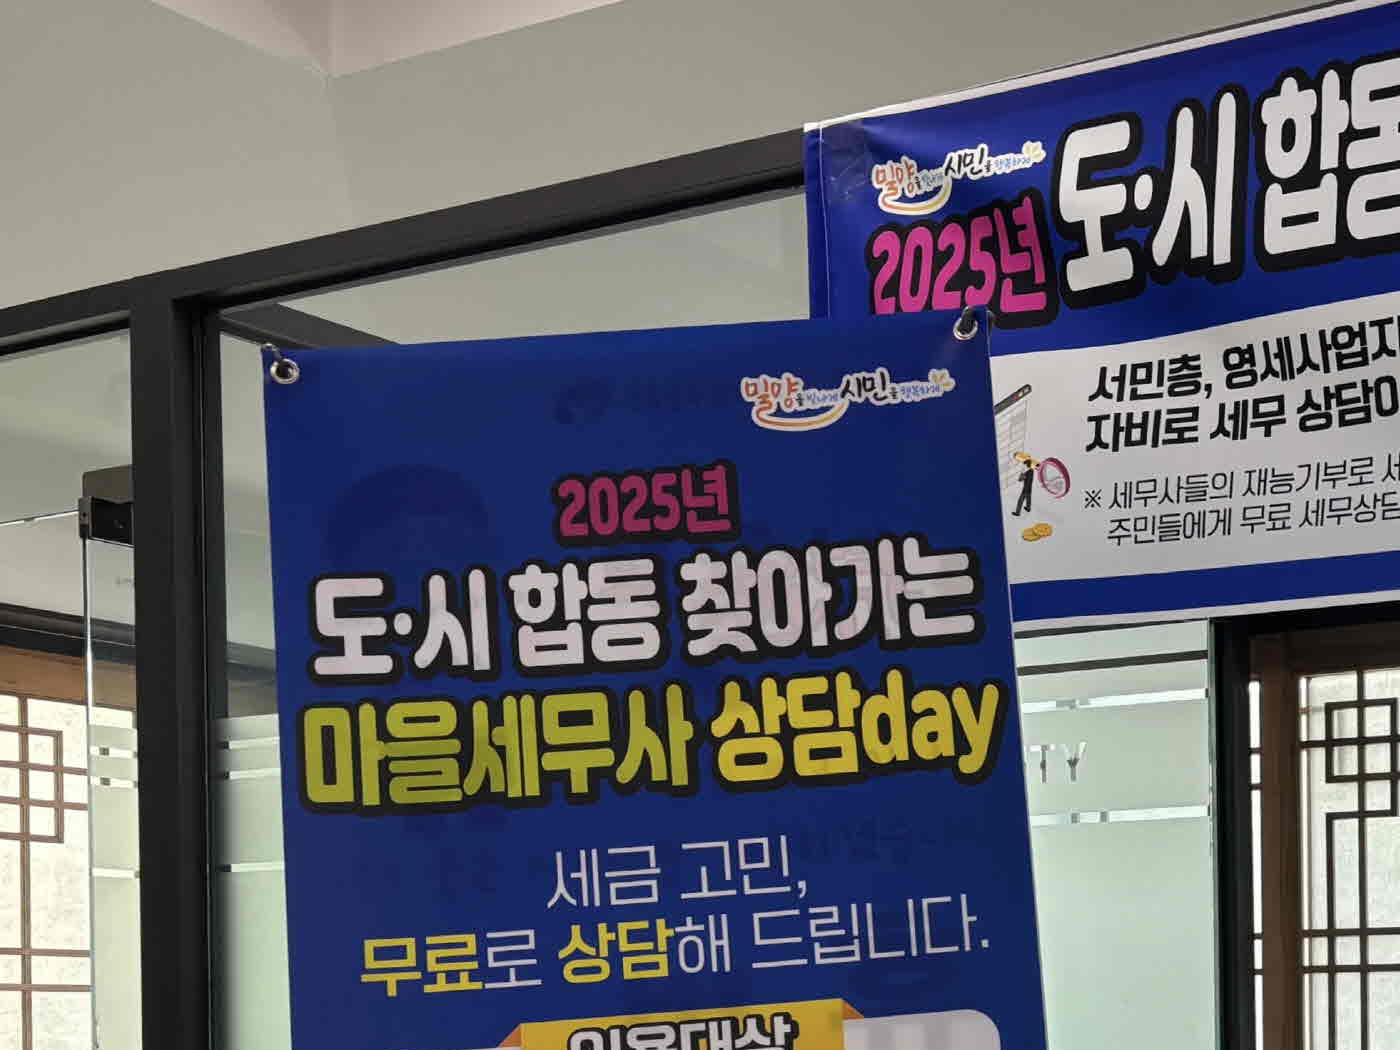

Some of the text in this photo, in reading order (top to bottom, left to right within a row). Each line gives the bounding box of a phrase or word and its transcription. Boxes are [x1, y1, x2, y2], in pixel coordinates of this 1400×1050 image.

[871, 194, 1047, 315] 2025년
[1088, 354, 1212, 403] 서민층,
[1085, 403, 1201, 453] 자비로
[1208, 394, 1286, 441] 세무
[557, 464, 731, 538] 2025년
[1110, 468, 1235, 511] 세무사들의
[1244, 456, 1374, 498] 재능기부로
[1107, 502, 1232, 546] 주민들에게
[1238, 502, 1291, 533] 무료
[508, 558, 661, 668] 합동
[680, 536, 976, 658] 찾아가는
[304, 669, 999, 806] 마을세무사 상담day
[546, 835, 808, 908] 세금 고민,
[360, 894, 992, 997] 무료로 상담해 드립니다.
